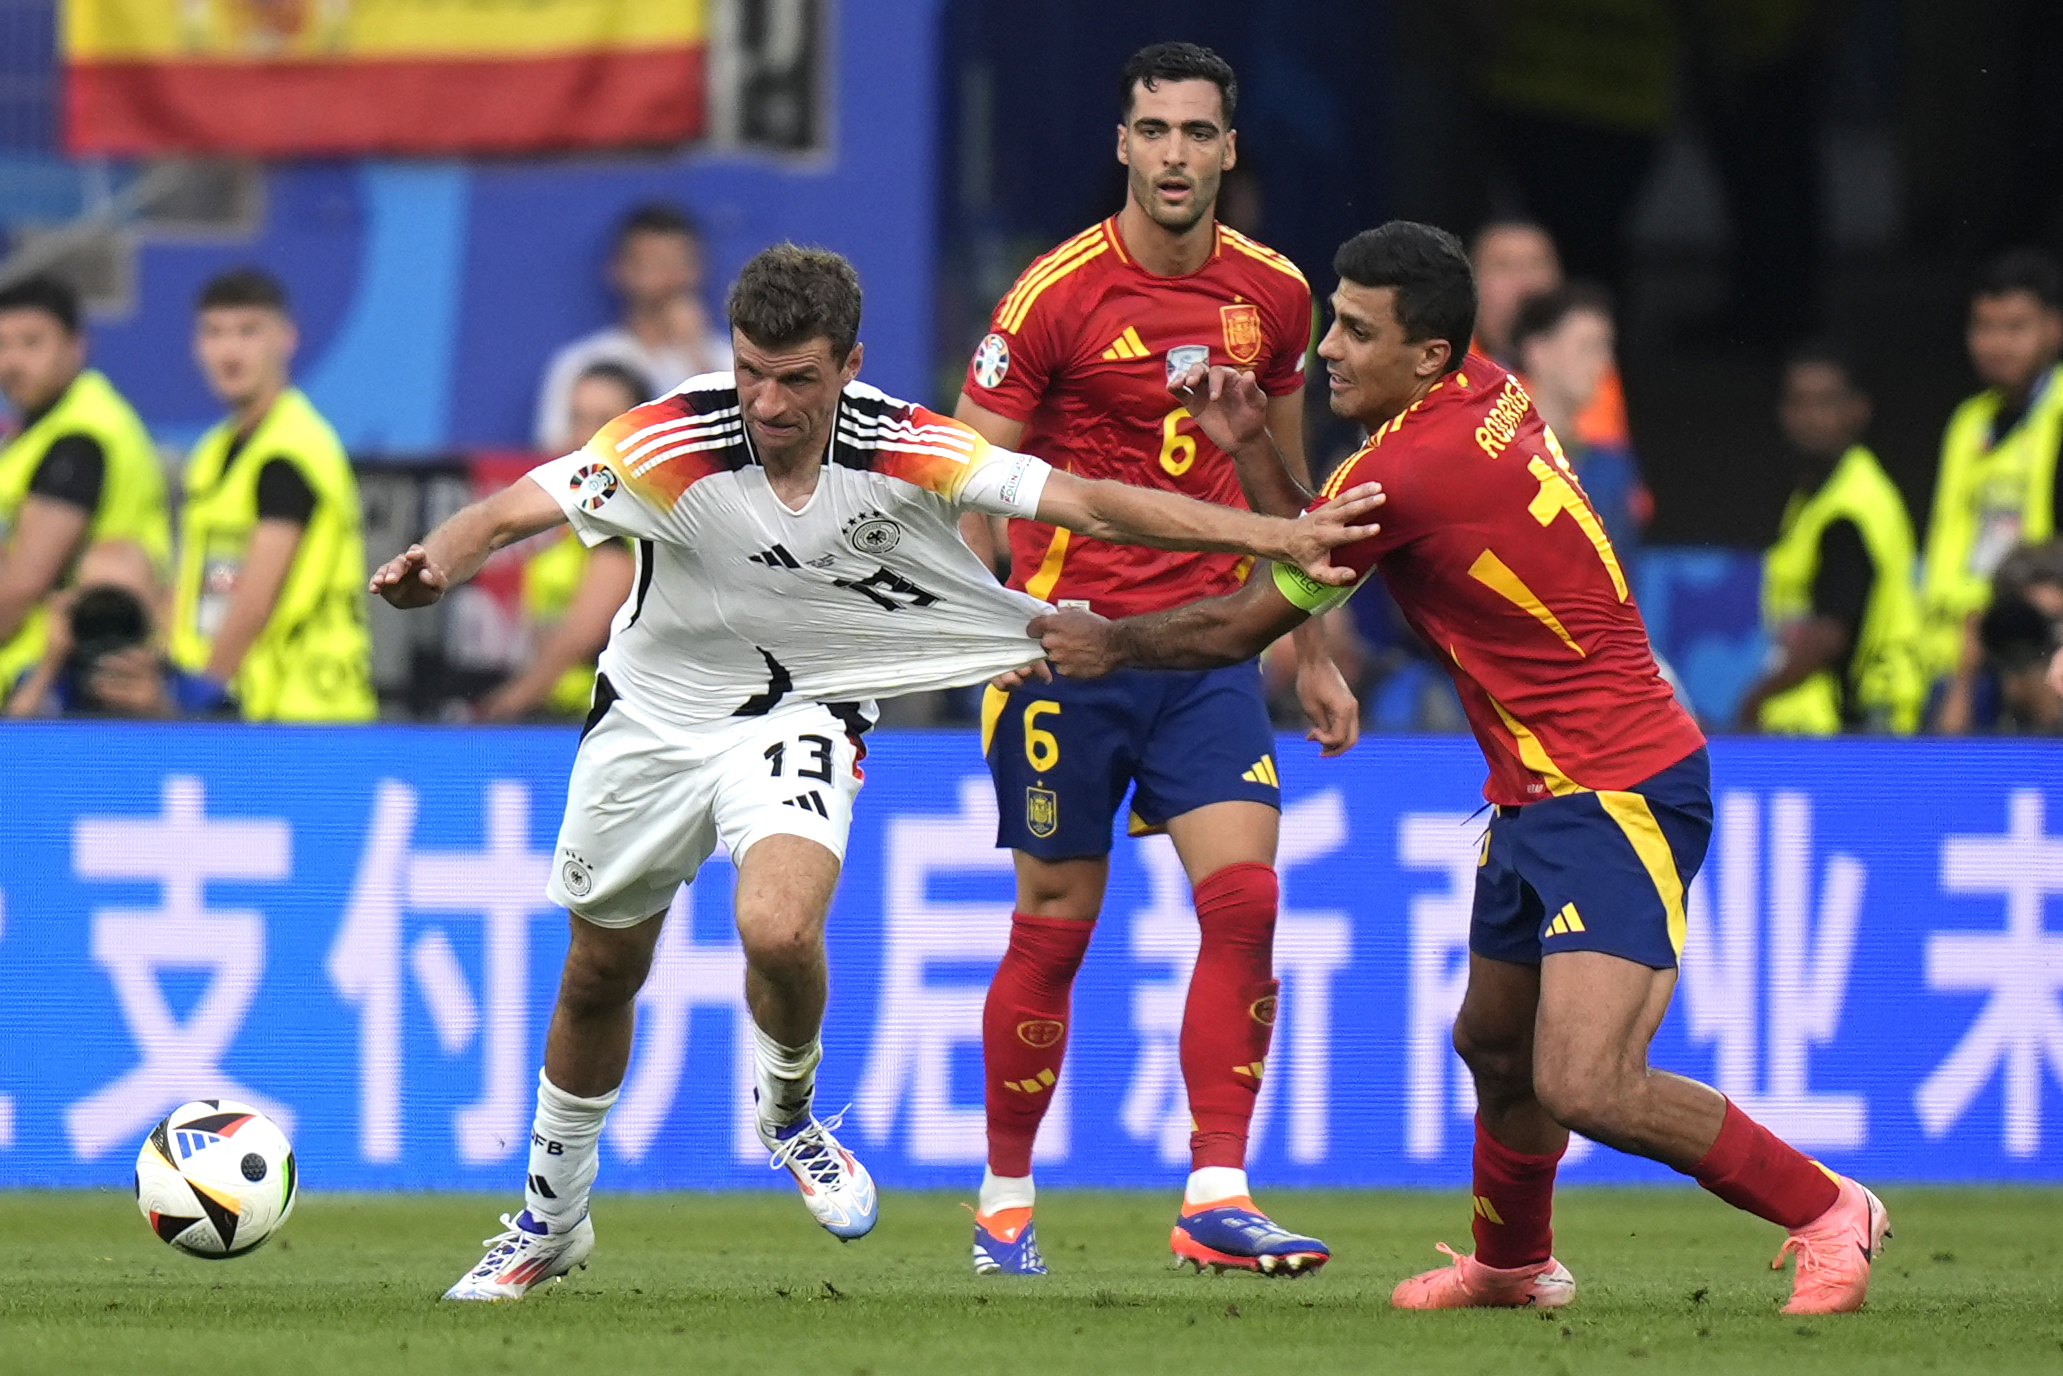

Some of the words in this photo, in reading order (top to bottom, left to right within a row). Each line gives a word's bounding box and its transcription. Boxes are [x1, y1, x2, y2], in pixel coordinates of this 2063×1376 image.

[1159, 407, 1197, 476] 6
[763, 733, 835, 788] 13
[1023, 699, 1061, 773] 6
[0, 772, 2063, 1163] 支付启新业未
